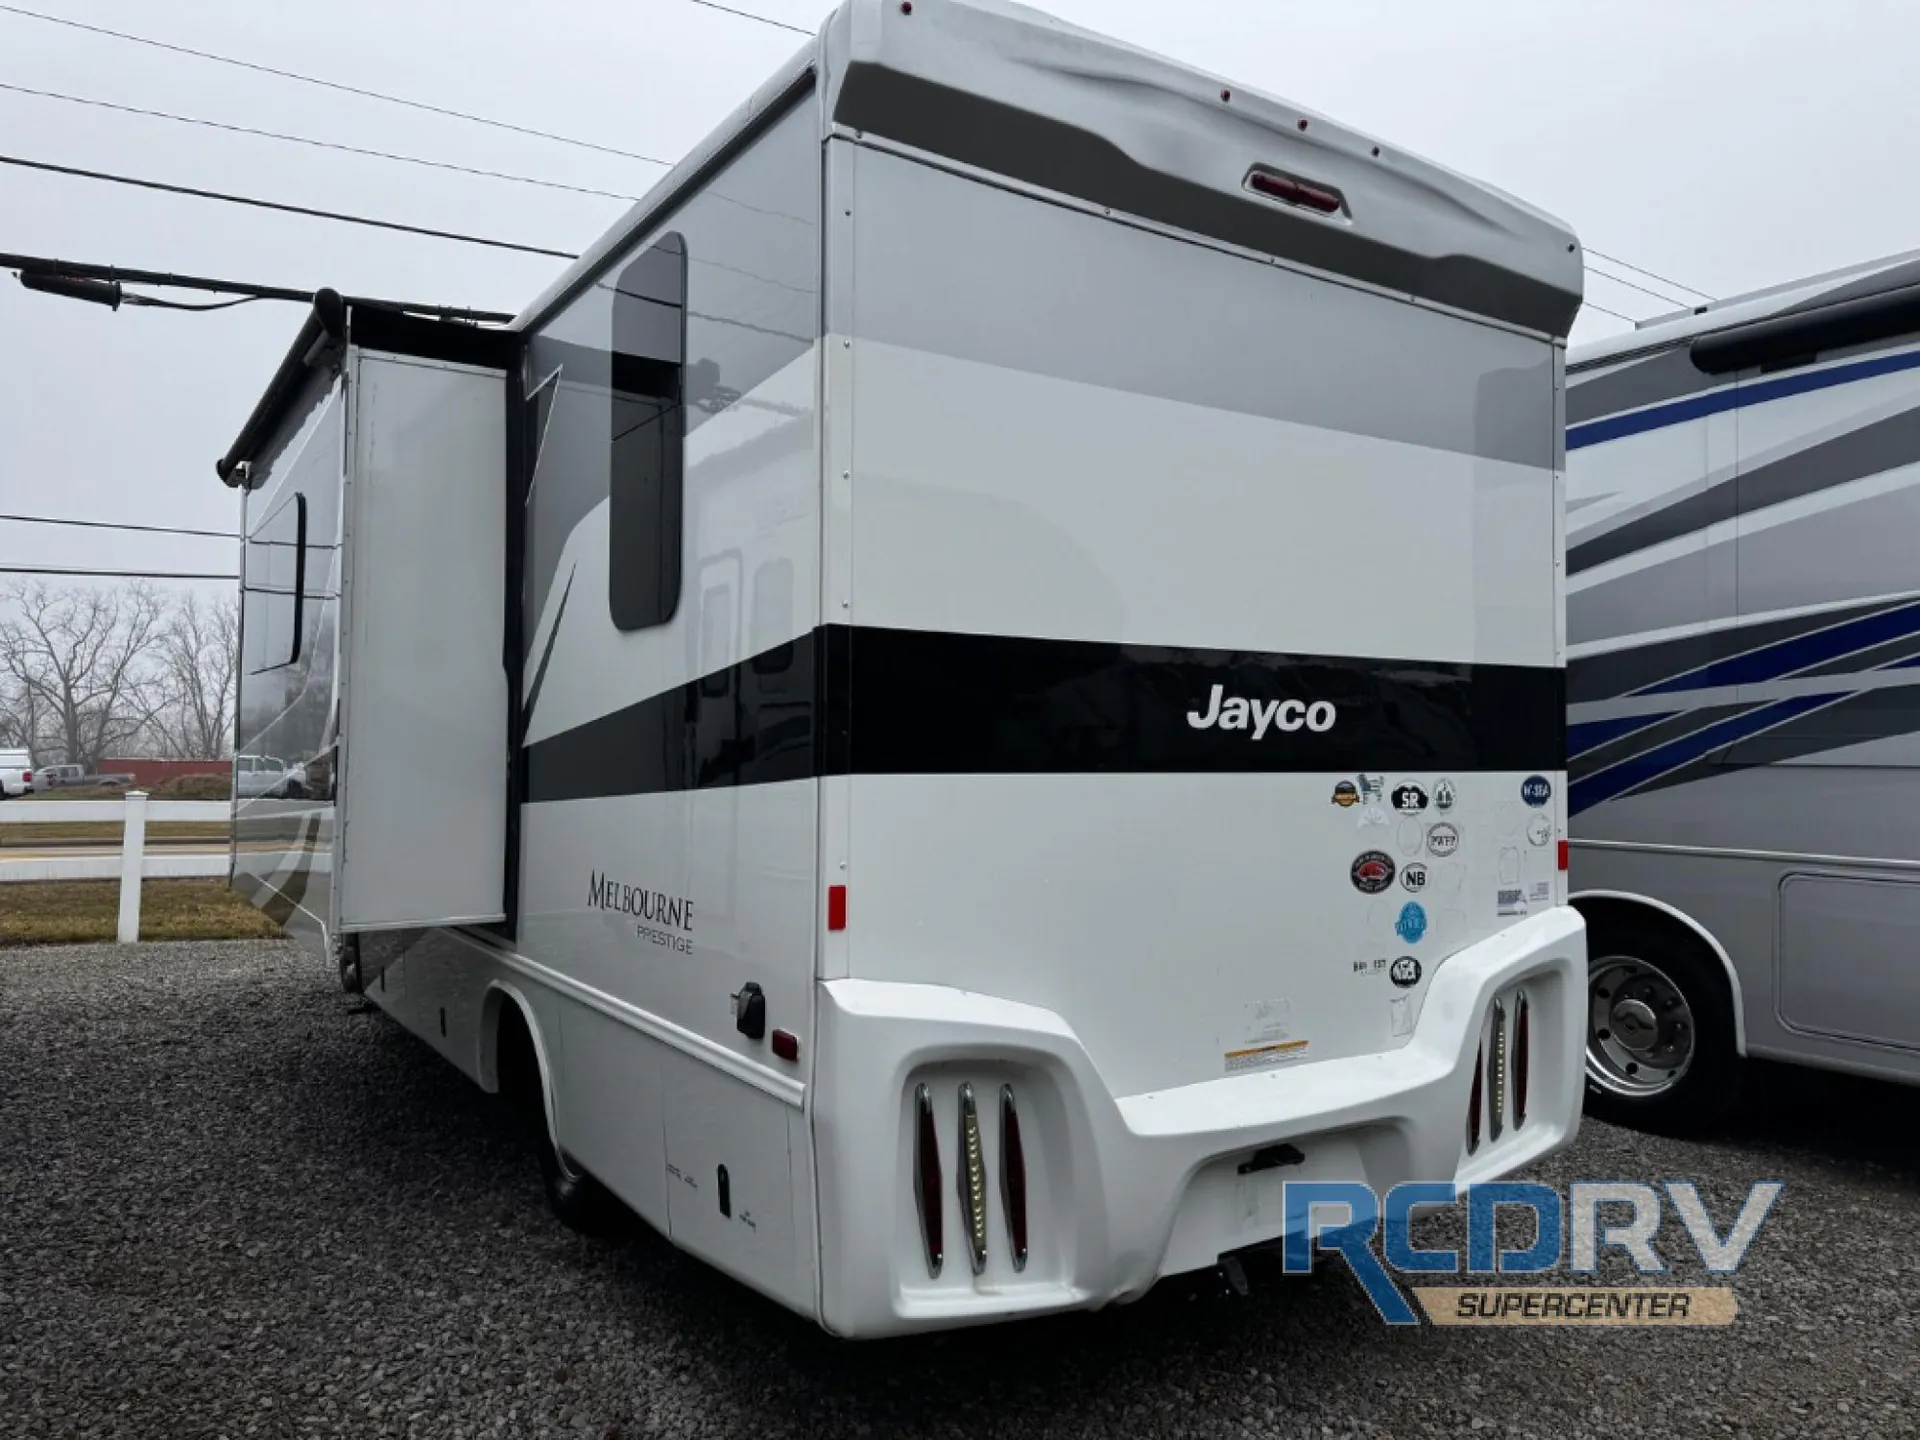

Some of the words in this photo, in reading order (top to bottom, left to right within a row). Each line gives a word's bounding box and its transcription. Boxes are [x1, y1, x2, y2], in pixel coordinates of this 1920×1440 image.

[1186, 683, 1337, 741] Jayco
[1401, 792, 1419, 807] SR
[1405, 871, 1426, 886] NB
[587, 867, 694, 932] MELBOURNE
